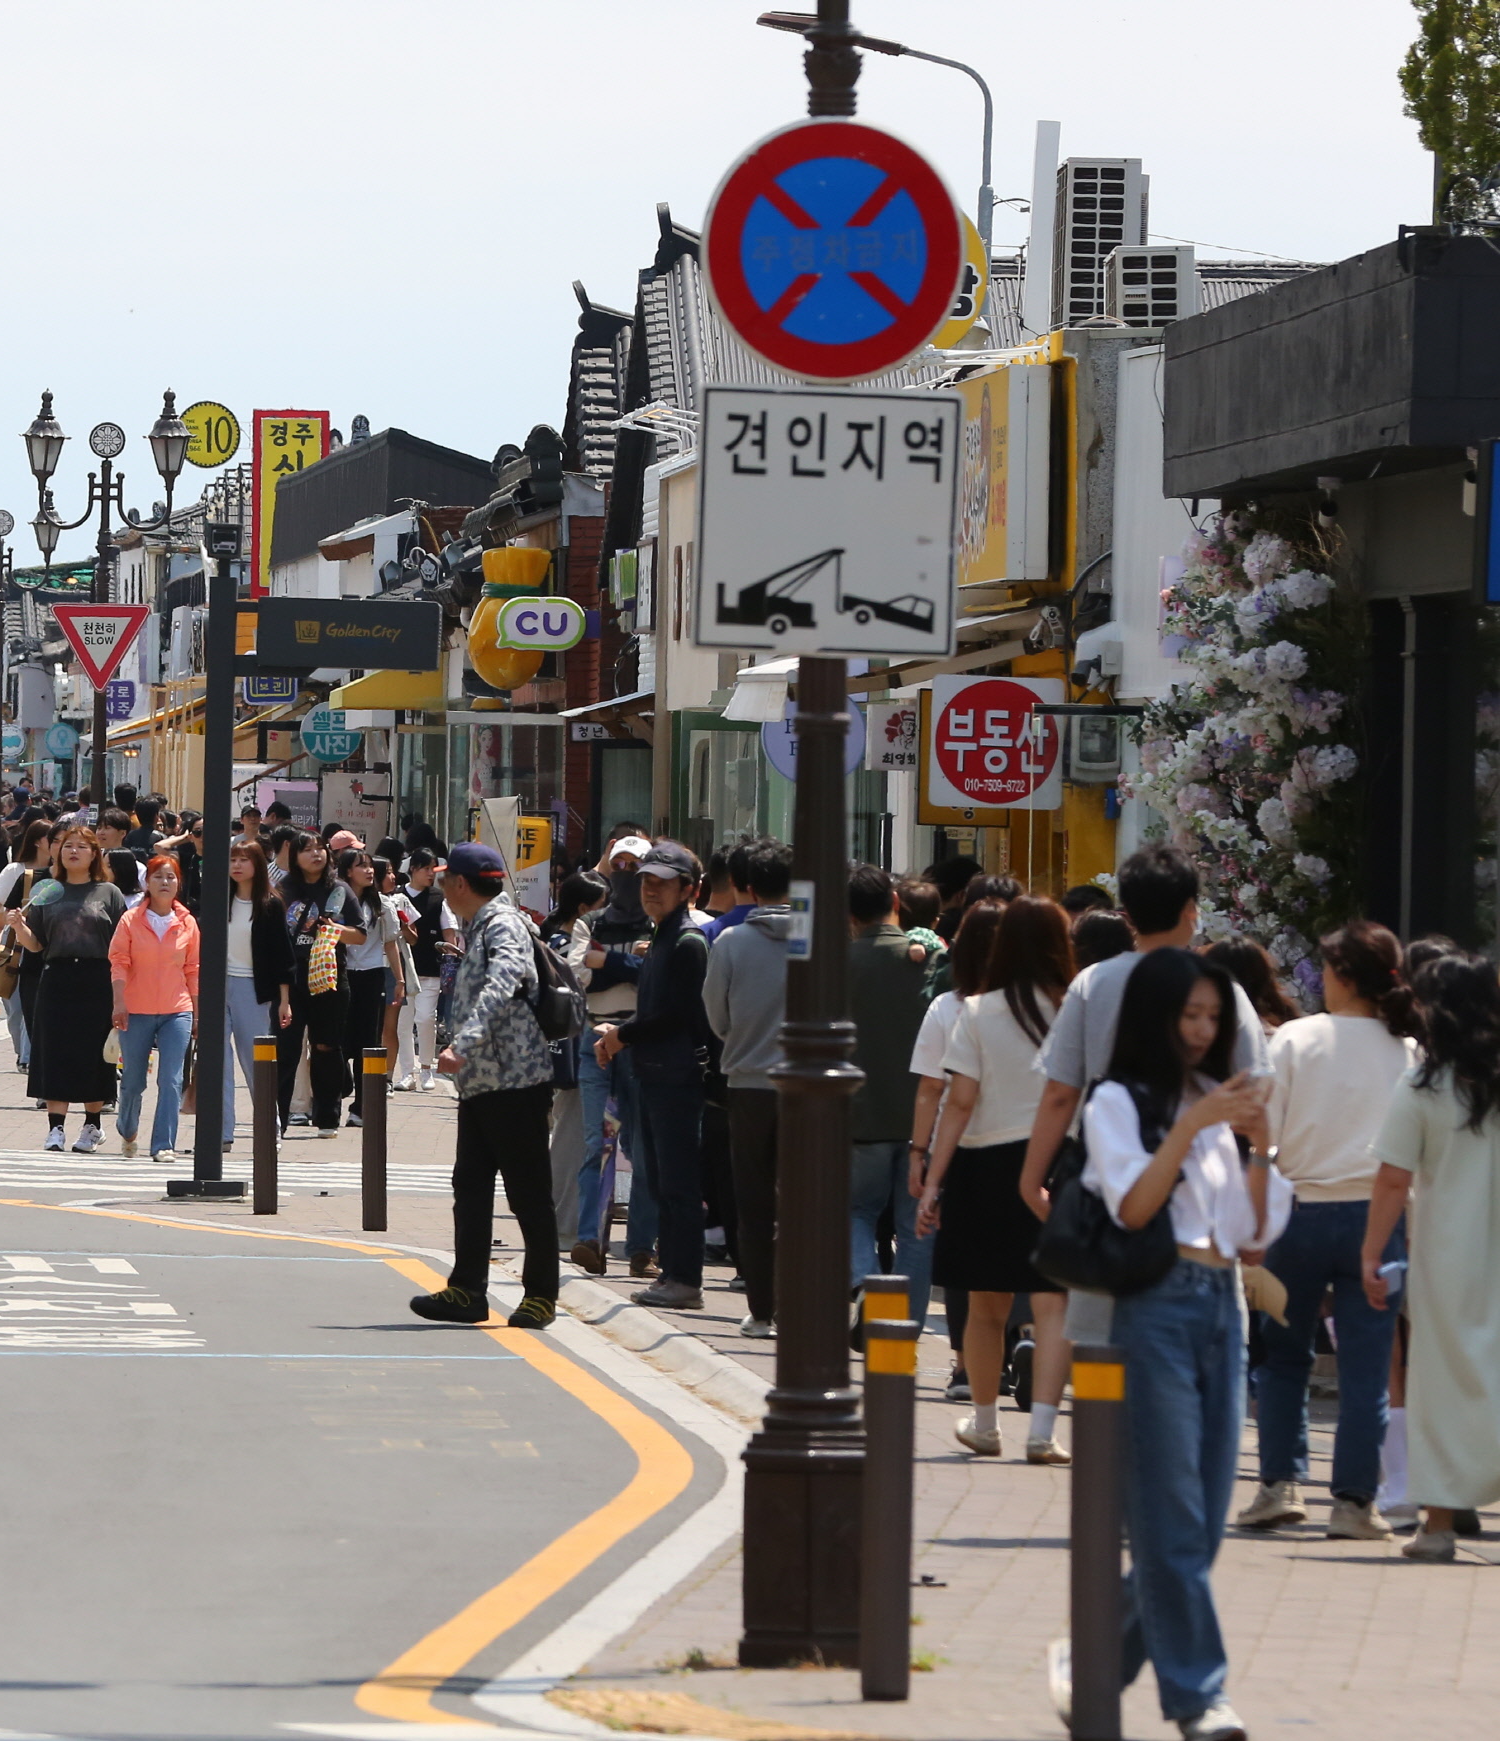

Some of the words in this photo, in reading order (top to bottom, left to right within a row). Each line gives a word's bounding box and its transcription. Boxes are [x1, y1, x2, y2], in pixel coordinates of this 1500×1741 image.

[752, 229, 918, 272] 주정차금지
[204, 415, 233, 454] 10
[269, 421, 315, 446] 경주
[724, 410, 944, 484] 견인지역
[83, 622, 116, 635] 천천히
[515, 610, 568, 637] CU
[84, 636, 114, 645] SLOW
[311, 734, 351, 756] 사진
[943, 707, 1049, 774] 부동산
[964, 777, 1025, 793] 010-7509-8722
